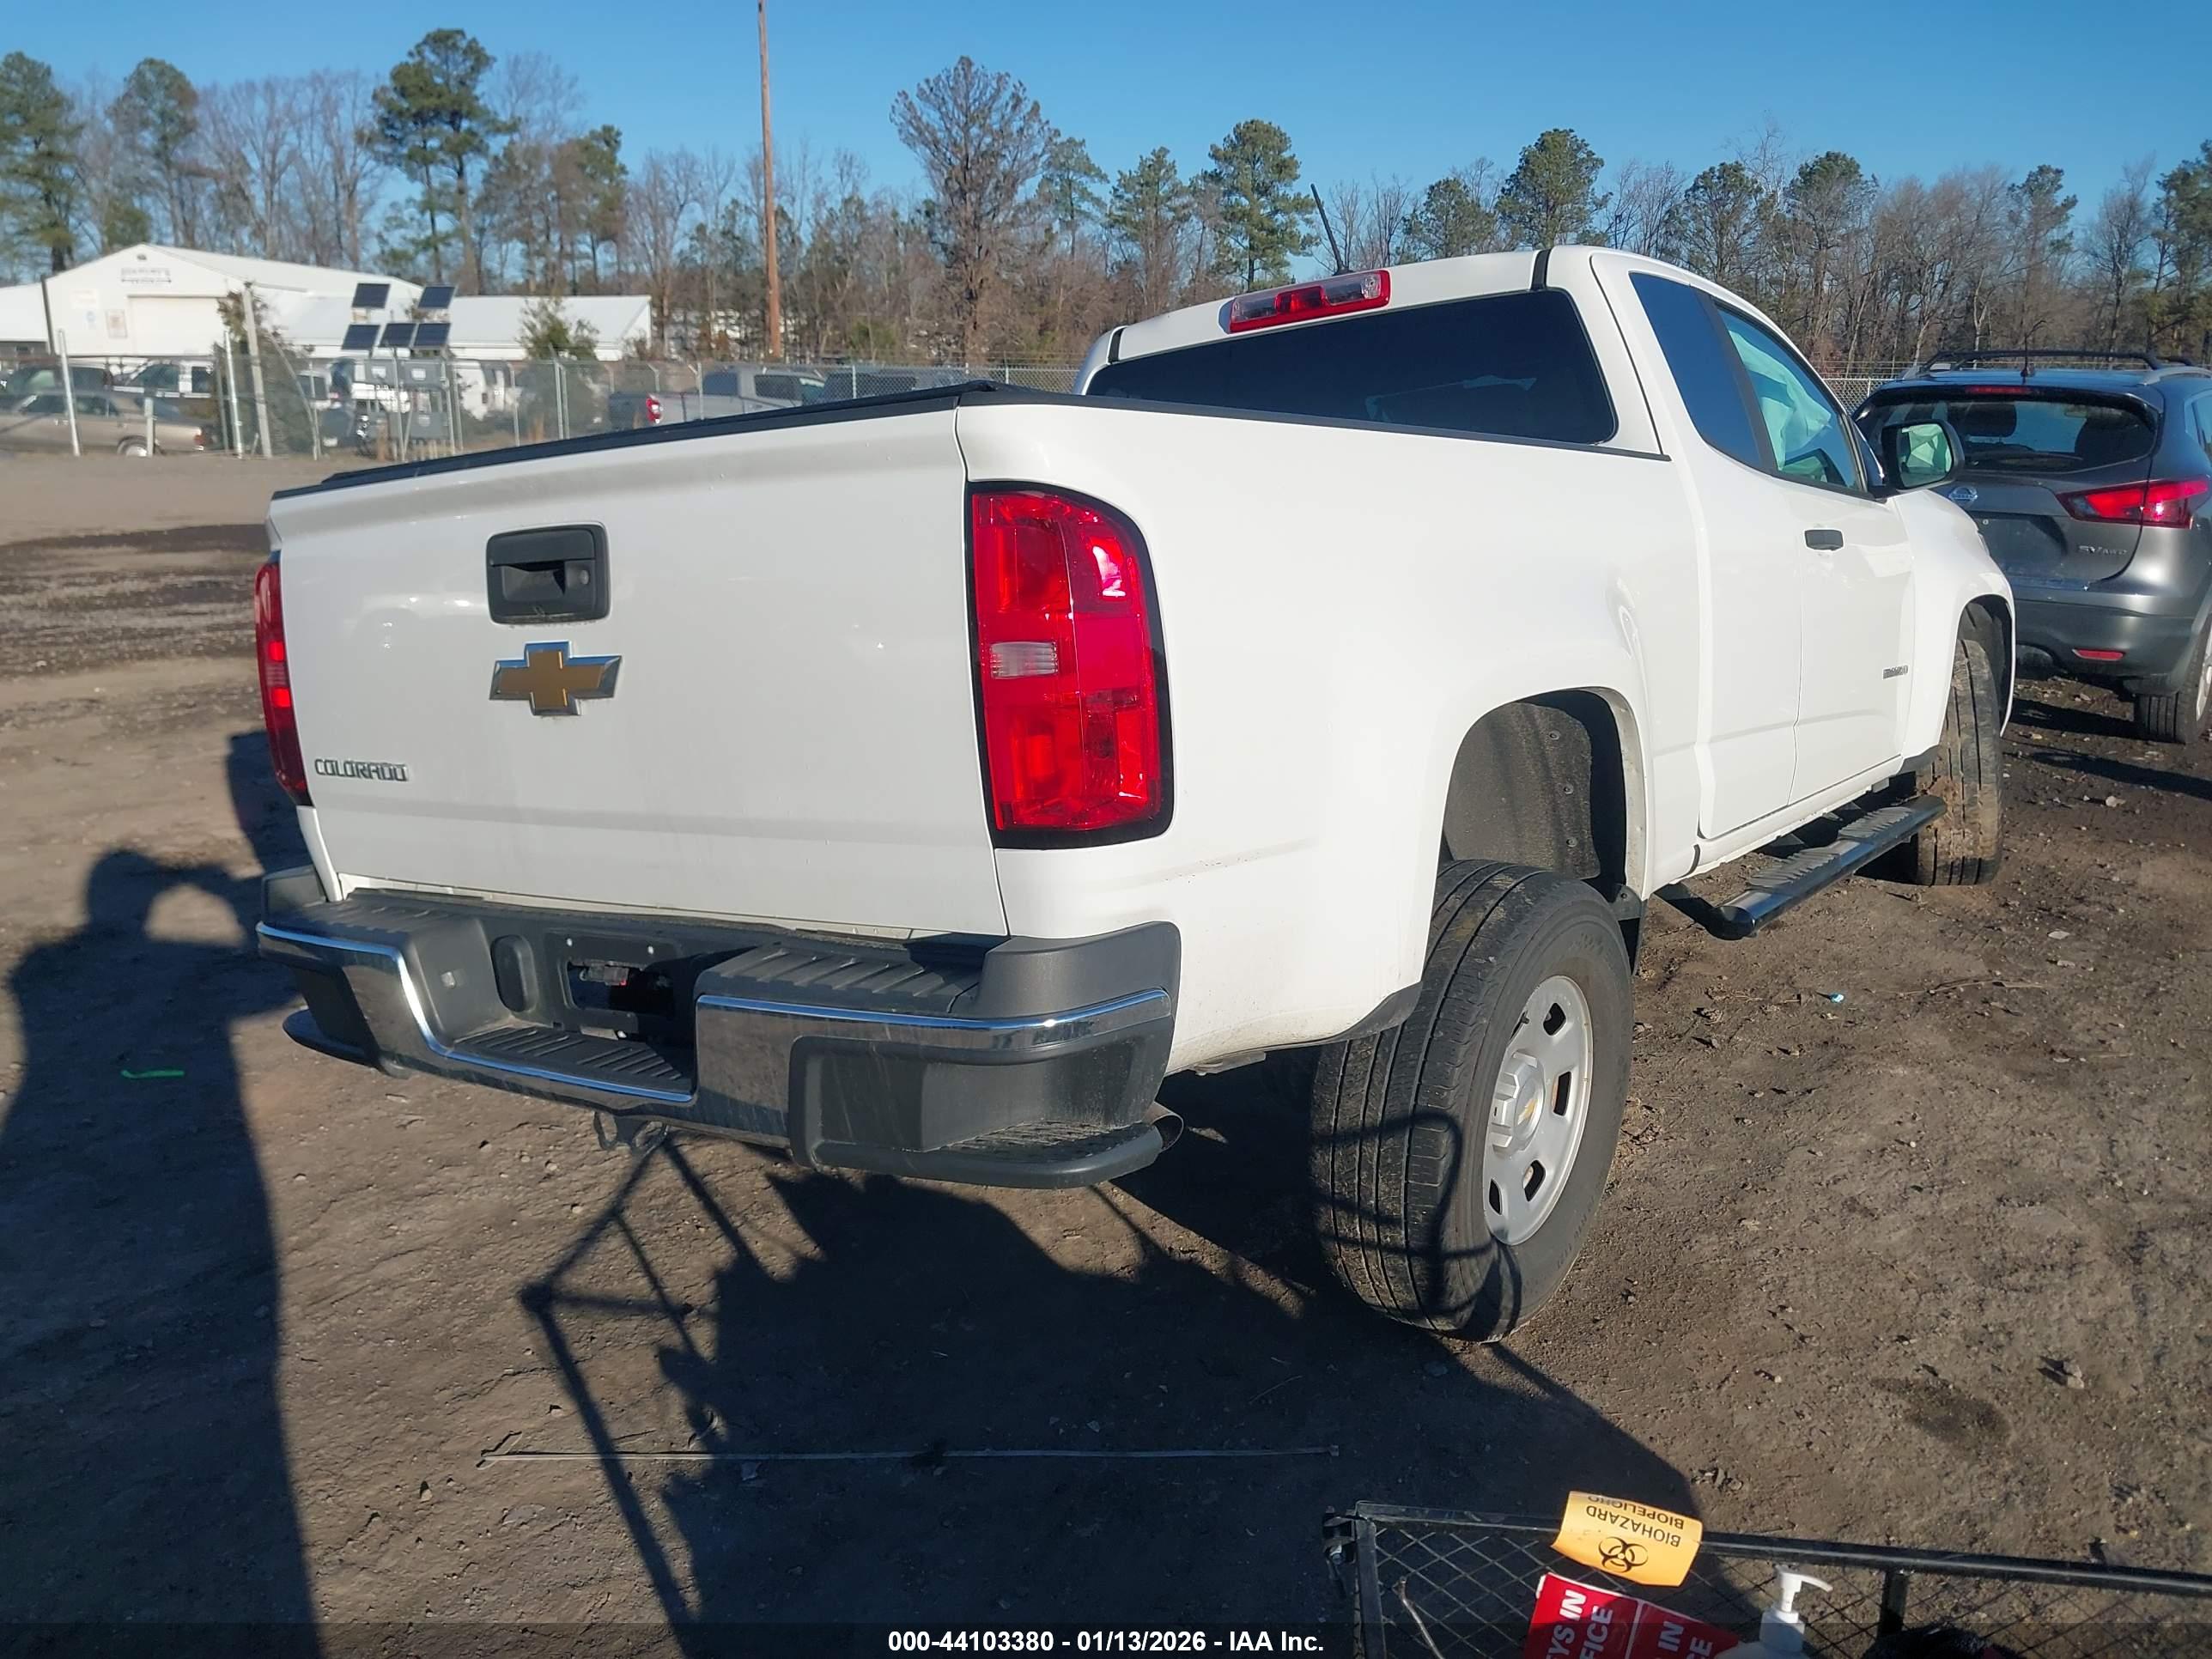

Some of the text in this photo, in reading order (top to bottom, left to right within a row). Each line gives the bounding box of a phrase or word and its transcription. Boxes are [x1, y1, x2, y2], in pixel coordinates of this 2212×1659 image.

[314, 758, 408, 781] COLORADO
[1586, 1505, 1681, 1547] BIOHAZARD
[1547, 1589, 1587, 1659] YS IN
[1658, 1620, 1685, 1652] IN
